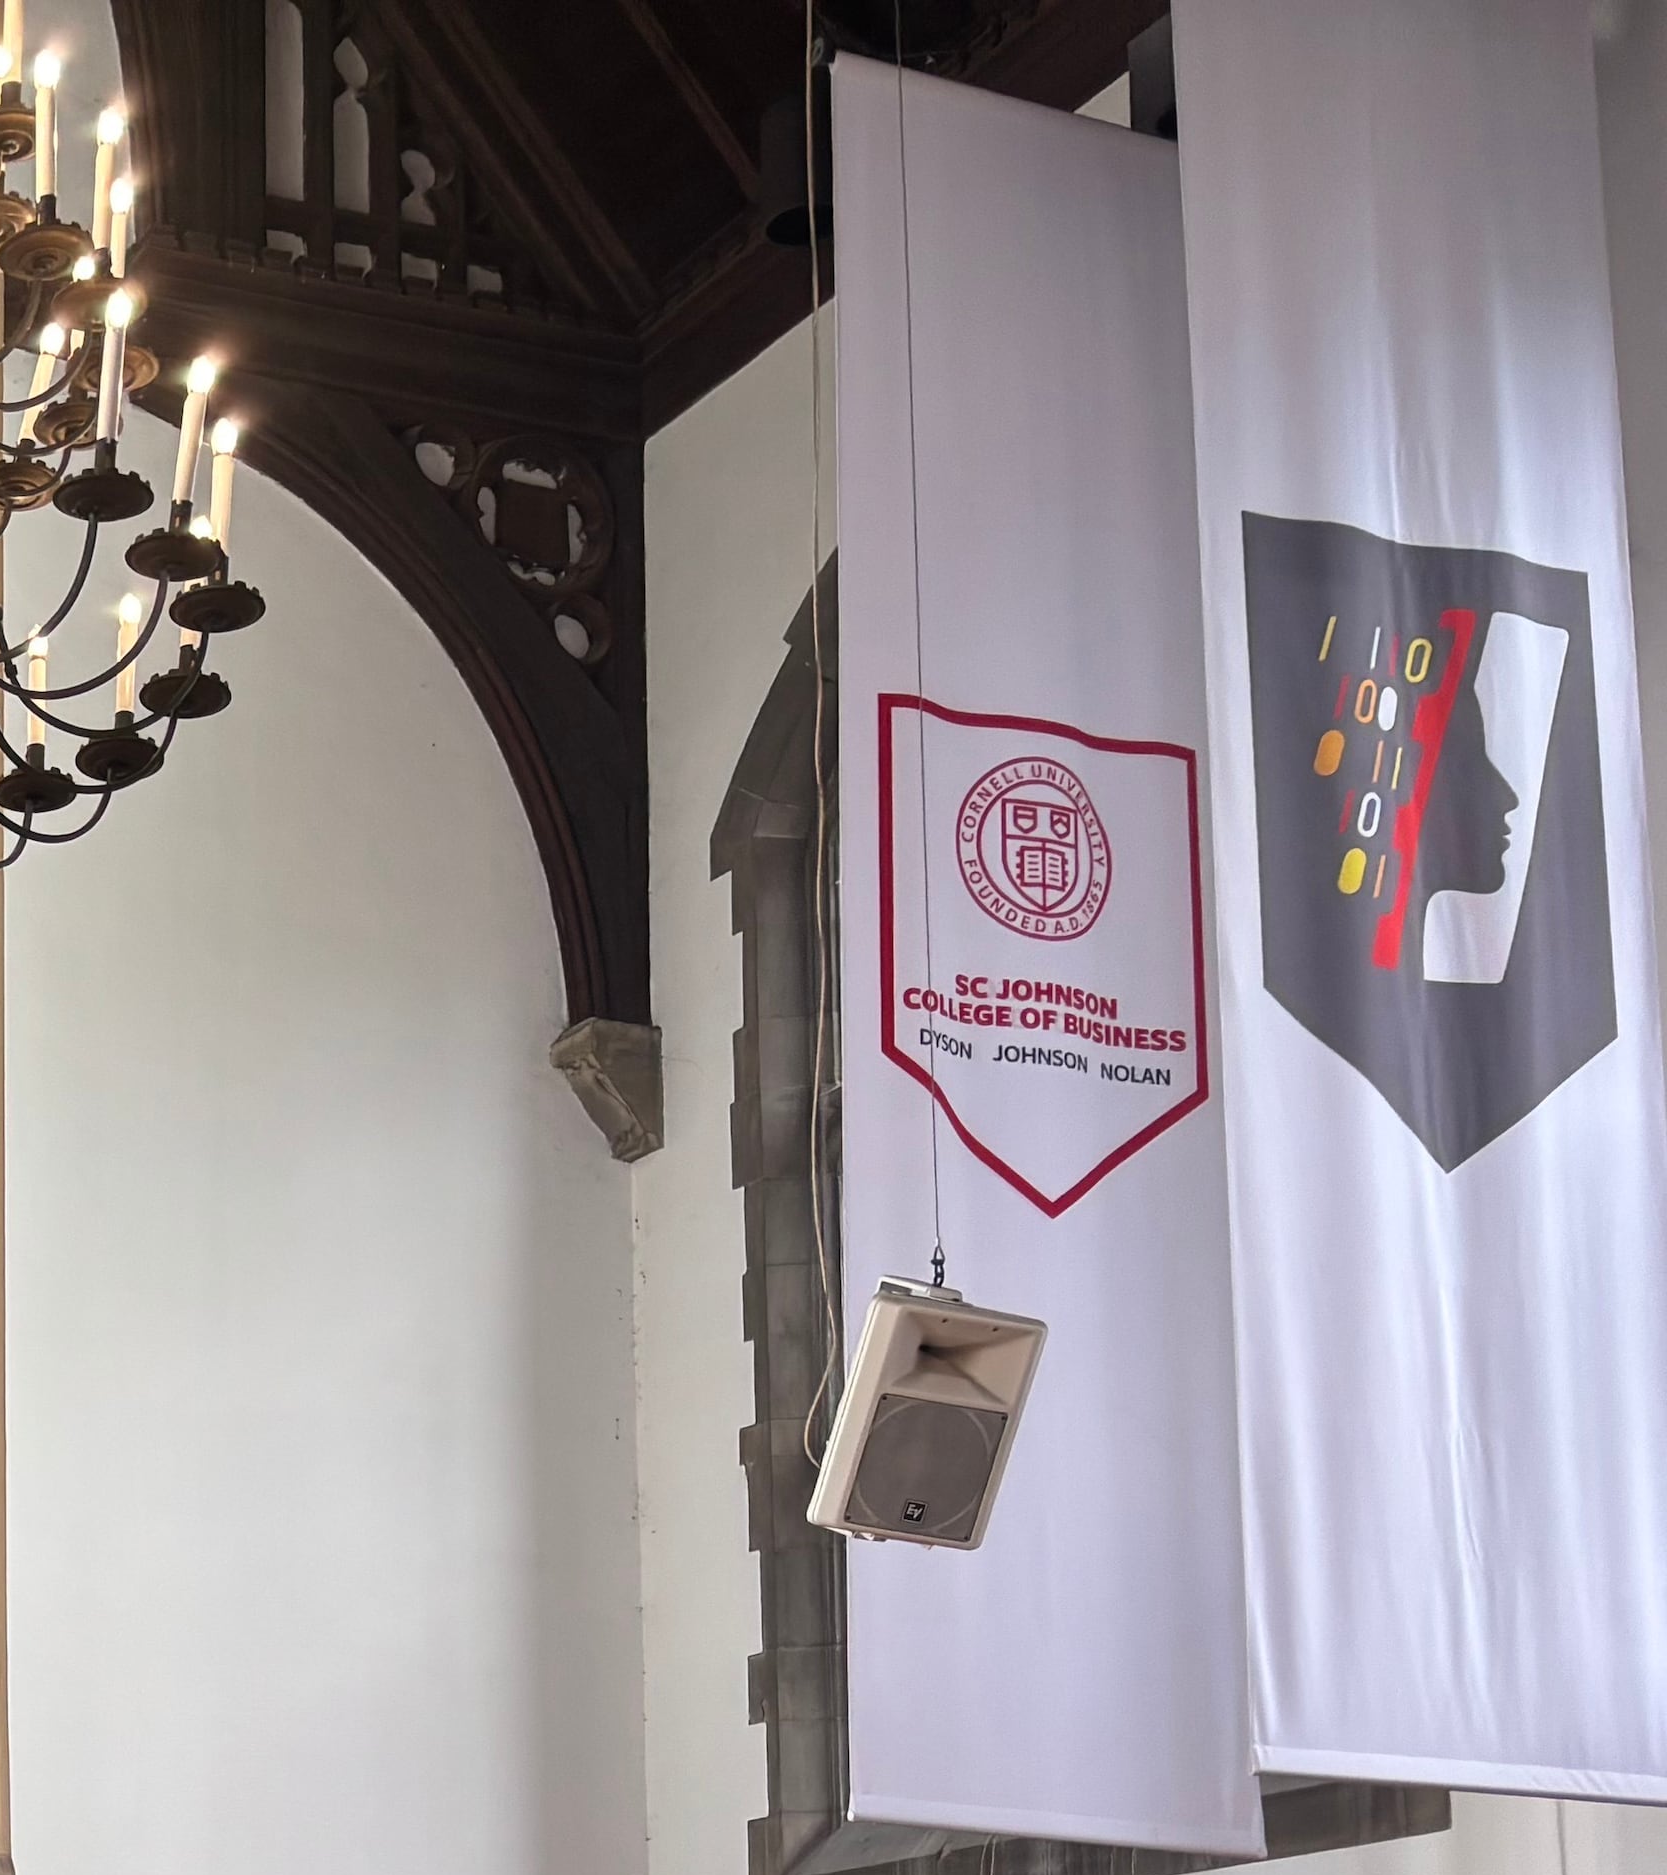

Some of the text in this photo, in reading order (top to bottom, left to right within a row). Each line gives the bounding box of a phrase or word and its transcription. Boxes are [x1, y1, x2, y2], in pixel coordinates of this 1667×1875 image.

[961, 764, 1105, 867] CORNELL UNIVERSITY
[964, 859, 1046, 933] FOUNDED
[1082, 879, 1103, 920] 1865
[902, 987, 1187, 1052] COLLEGE OF BUSINESS
[954, 974, 1118, 1020] SC JOHNSON
[919, 1028, 1171, 1086] DYSON JOHNSON NOLAN
